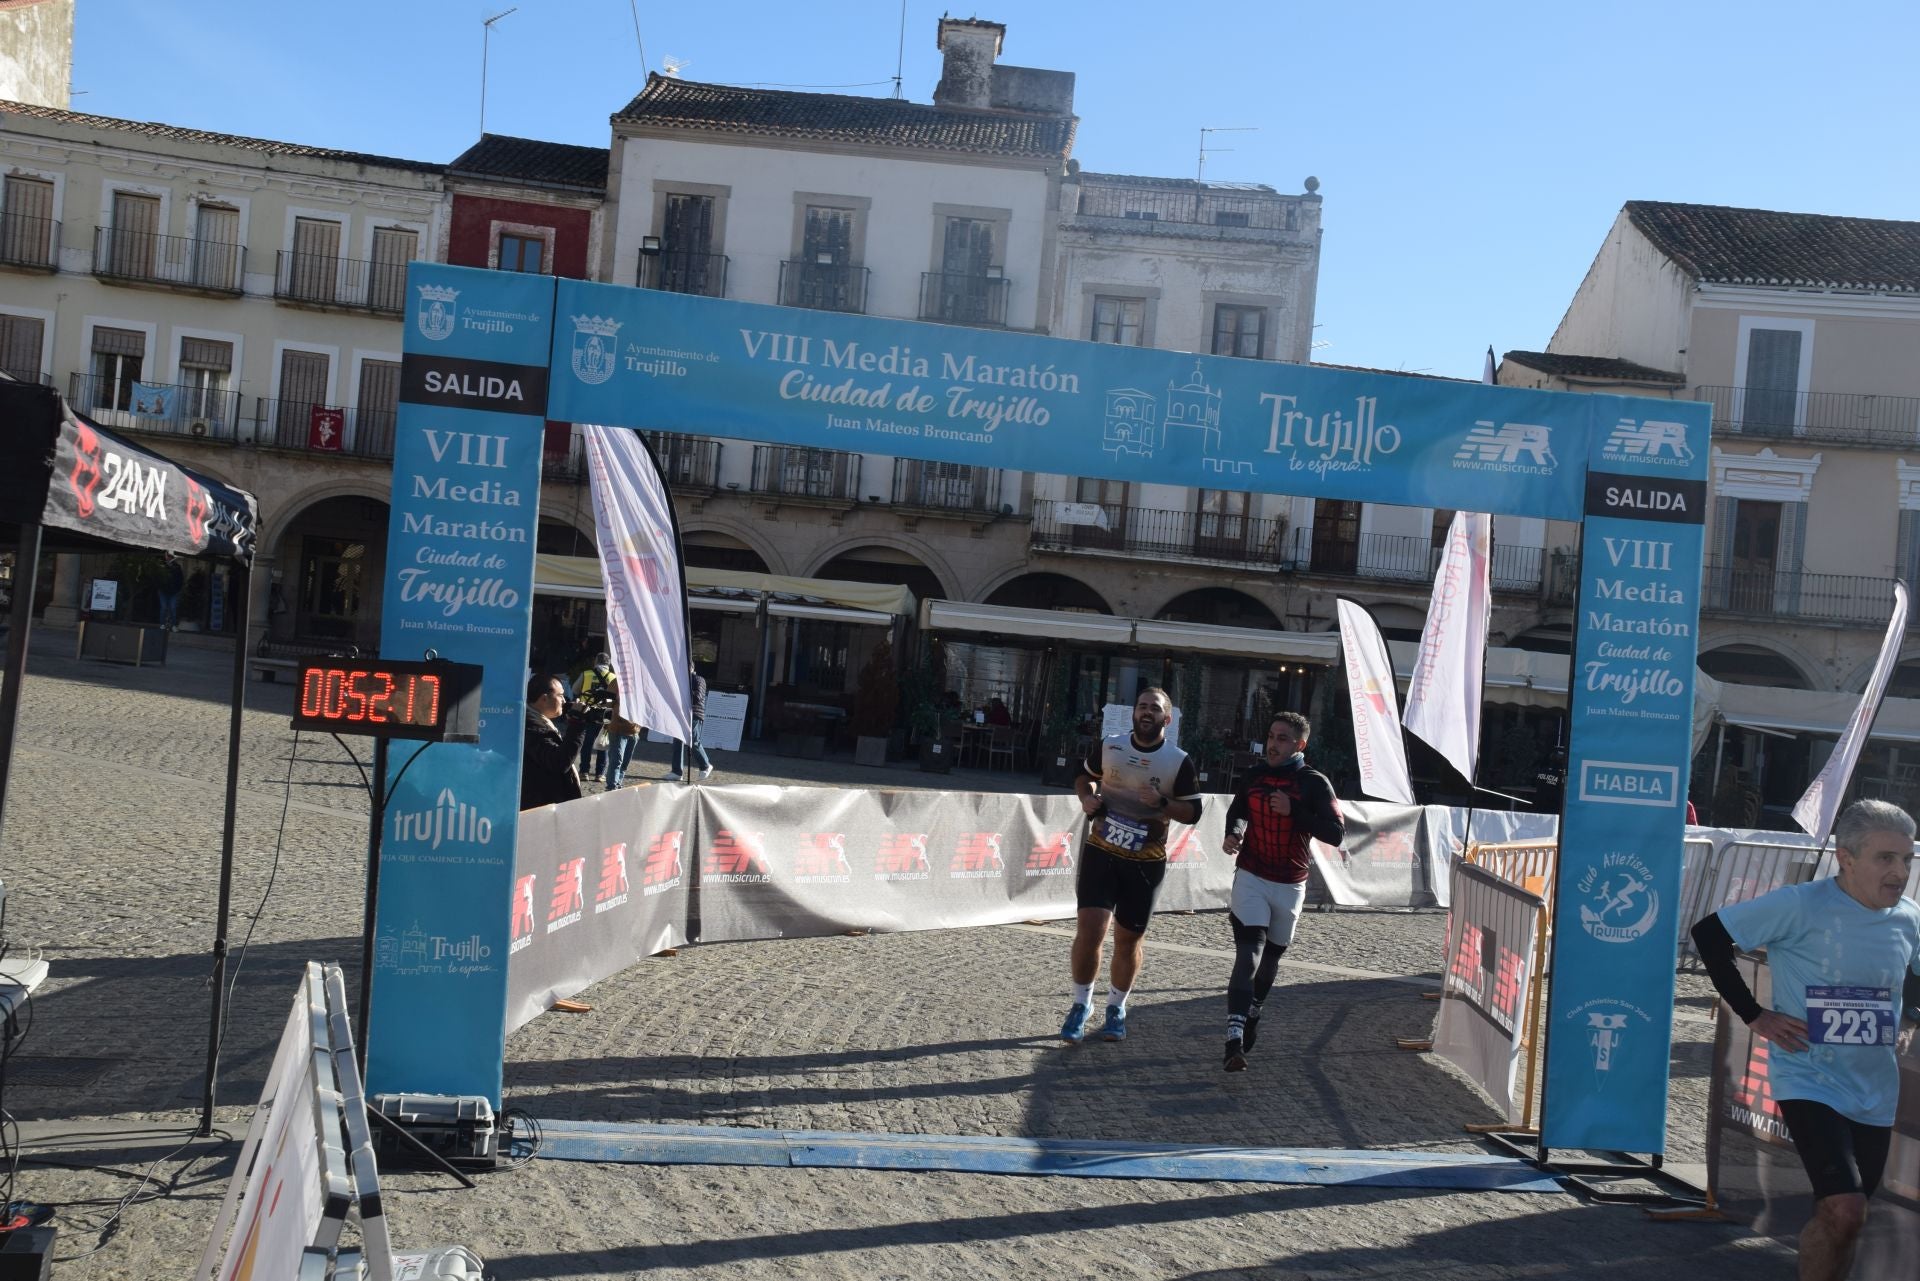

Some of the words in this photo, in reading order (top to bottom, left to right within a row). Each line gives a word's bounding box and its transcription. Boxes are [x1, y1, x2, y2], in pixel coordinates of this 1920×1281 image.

[463, 306, 527, 320] Ayuntamiento
[529, 313, 540, 322] de
[462, 318, 514, 334] Trujillo
[626, 342, 704, 362] Ayuntamiento
[706, 352, 720, 363] de
[740, 328, 811, 365] VIII
[822, 338, 930, 379] Media
[941, 352, 1080, 394] Maratón
[624, 357, 688, 378] Trujillo
[424, 371, 524, 402] SALIDA
[779, 370, 892, 409] Ciudad
[896, 385, 937, 414] de
[946, 385, 1050, 432] Trujillo
[826, 414, 862, 431] Juan
[866, 418, 920, 436] Mateos
[924, 424, 994, 444] Broncano
[1260, 392, 1400, 466] Trujillo
[422, 428, 510, 468] VIII
[1288, 455, 1304, 472] te
[1452, 459, 1554, 476] www.musicrun.es
[1602, 451, 1690, 467] www.musicrun.es
[412, 474, 520, 506] Media
[1605, 487, 1686, 512] SALIDA
[401, 512, 527, 543] Maratón
[416, 546, 486, 568] Ciudad
[488, 554, 507, 570] de
[1603, 537, 1673, 571] VIII
[398, 567, 519, 617] Trujillo
[1594, 578, 1684, 605] Media
[400, 618, 424, 632] Juan
[428, 620, 464, 633] Mateos
[466, 622, 514, 636] Broncano
[1587, 611, 1690, 637] Maratón
[1598, 642, 1650, 660] Ciudad
[1652, 647, 1672, 662] de
[1584, 661, 1684, 704] Trujillo
[502, 706, 514, 714] de
[1586, 706, 1606, 716] Juan
[1608, 707, 1638, 718] Mateos
[1640, 709, 1680, 720] Broncano
[1594, 774, 1664, 794] HABLA
[394, 787, 492, 850] trujillo
[1105, 824, 1134, 850] 232
[398, 854, 416, 862] QUE
[418, 855, 462, 864] COMIENCE
[466, 856, 476, 864] LA
[478, 857, 505, 865] MAGIA
[703, 873, 771, 884] www.musicrun.es
[795, 872, 850, 884] www.musicrun.es
[874, 872, 928, 881] www.musicrun.es
[950, 870, 1002, 880] www.musicrun.es
[1025, 866, 1072, 878] www.musicrun.es
[1577, 864, 1598, 894] Club
[1603, 851, 1654, 881] Atletismo
[1586, 920, 1640, 939] TRUJILLO
[430, 935, 491, 962] Trujillo
[448, 962, 459, 974] te
[1566, 1005, 1584, 1019] Club
[1620, 1000, 1634, 1010] San
[1822, 1008, 1878, 1044] 223
